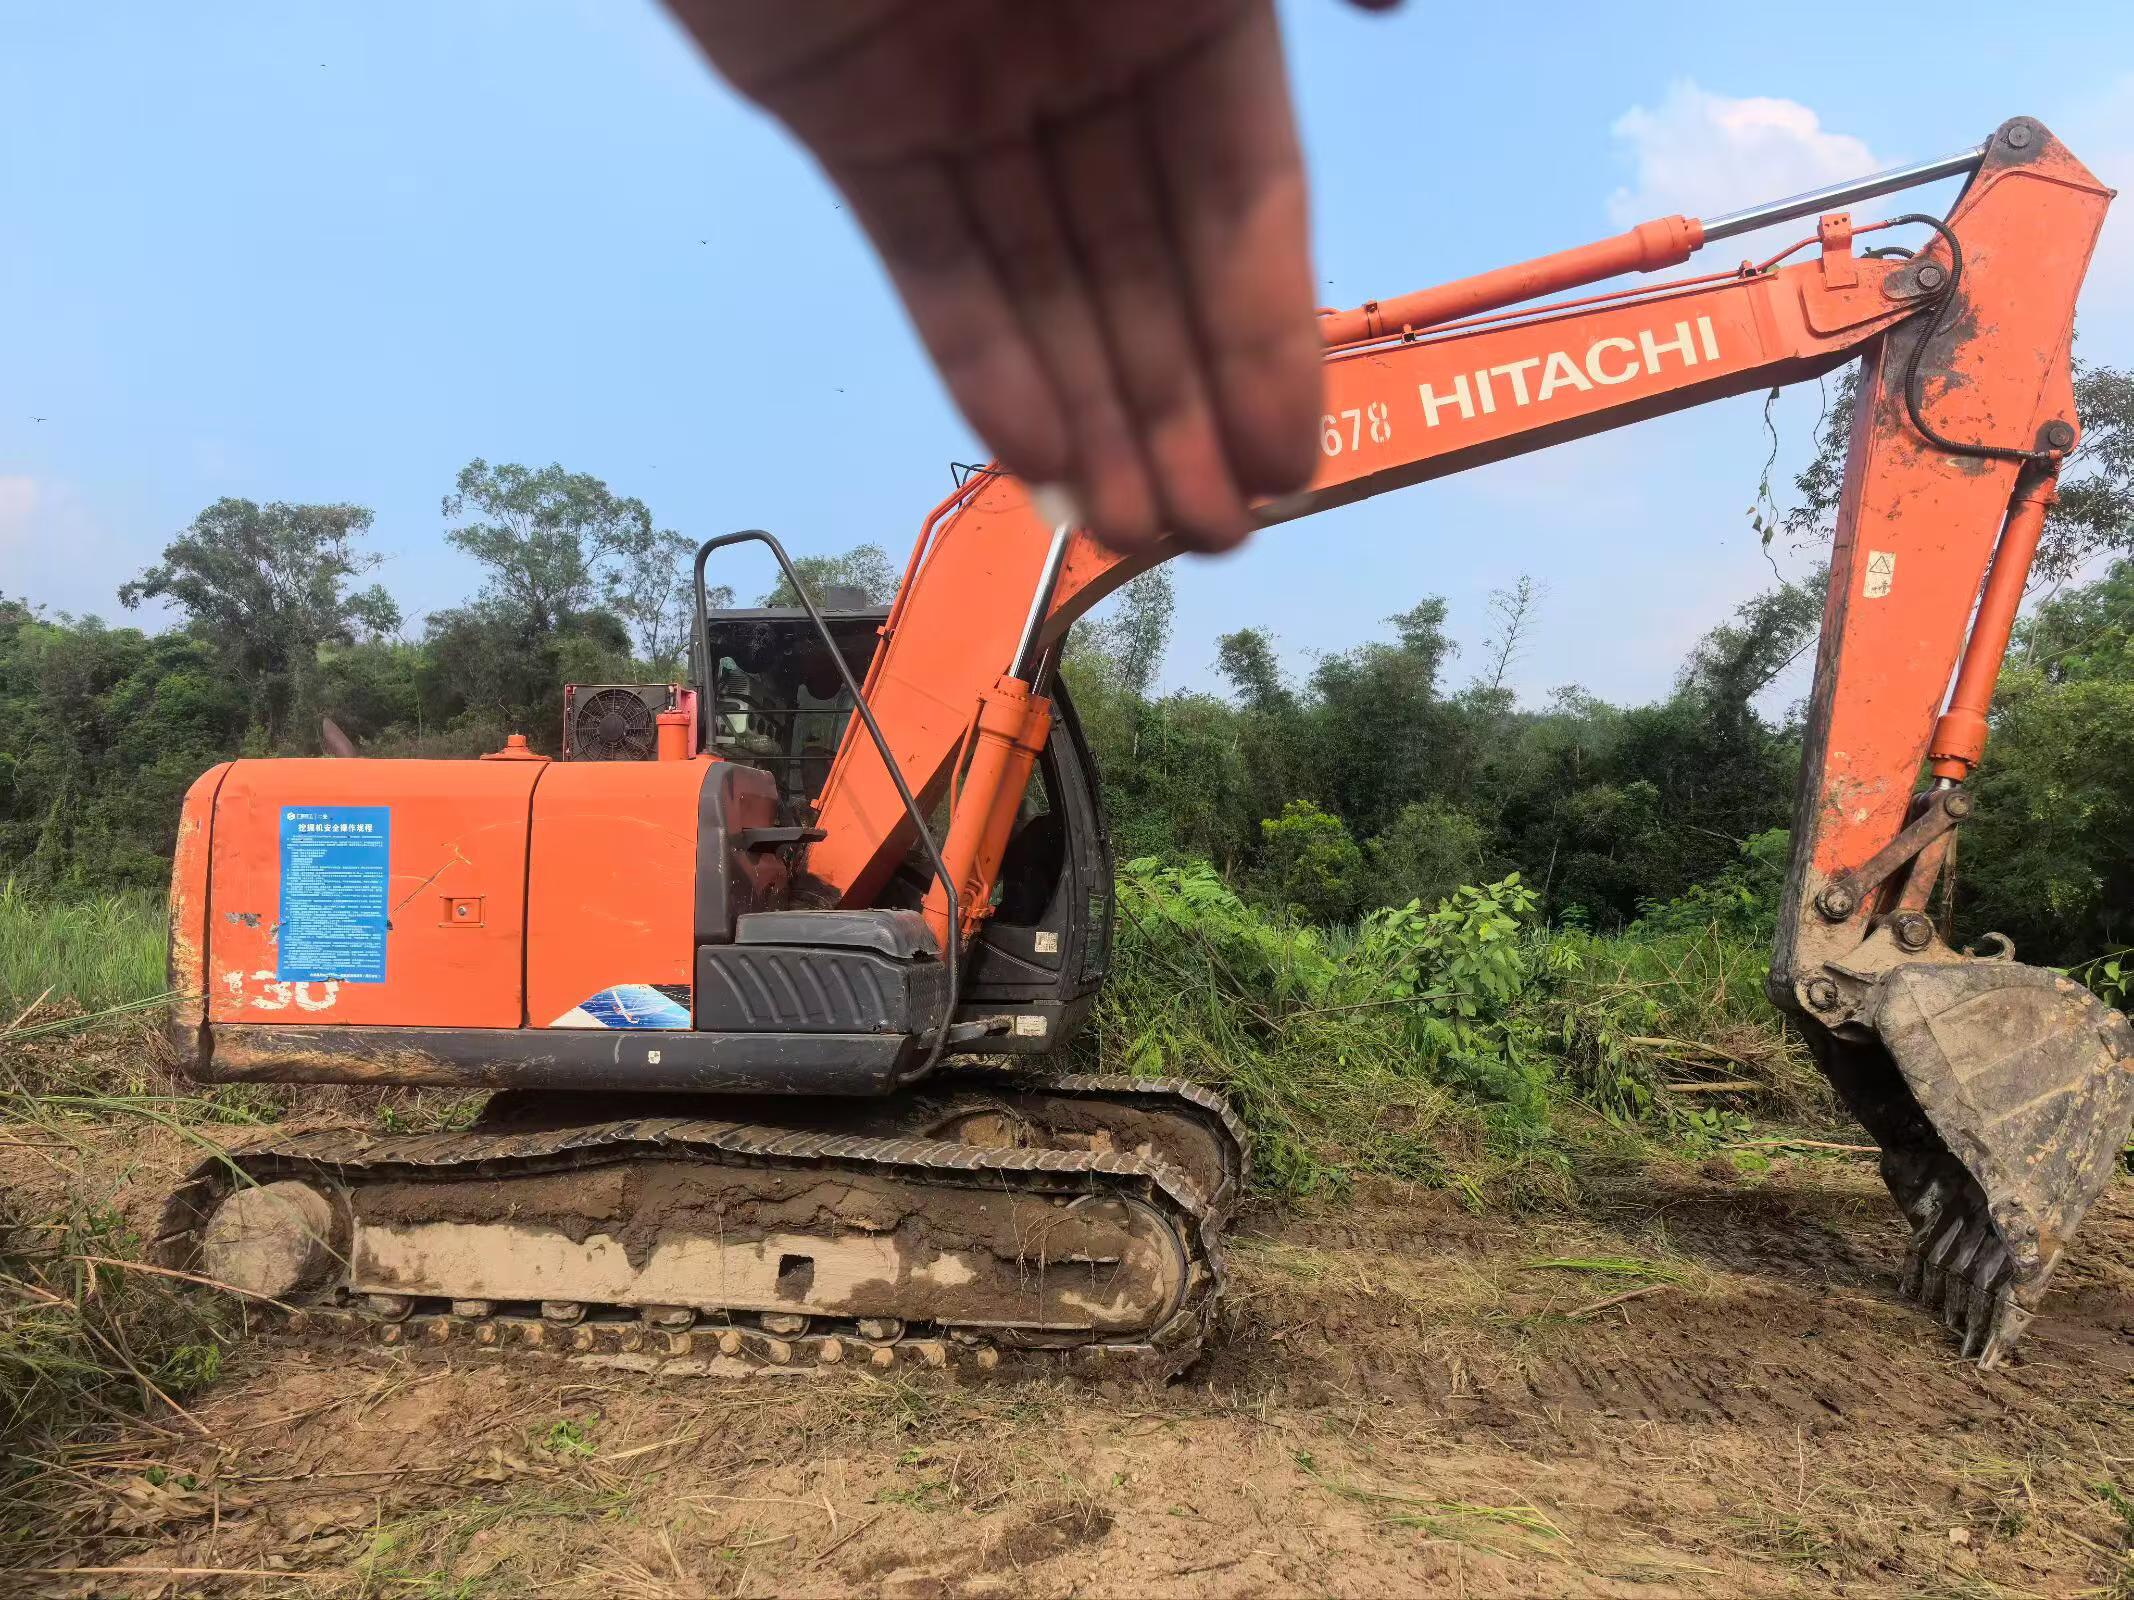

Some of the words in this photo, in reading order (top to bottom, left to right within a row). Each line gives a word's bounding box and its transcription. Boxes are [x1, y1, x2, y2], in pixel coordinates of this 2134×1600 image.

[1320, 400, 1391, 456] 678
[1418, 316, 1720, 427] HITACHI
[298, 823, 373, 832] 挖掘机安全操作规程
